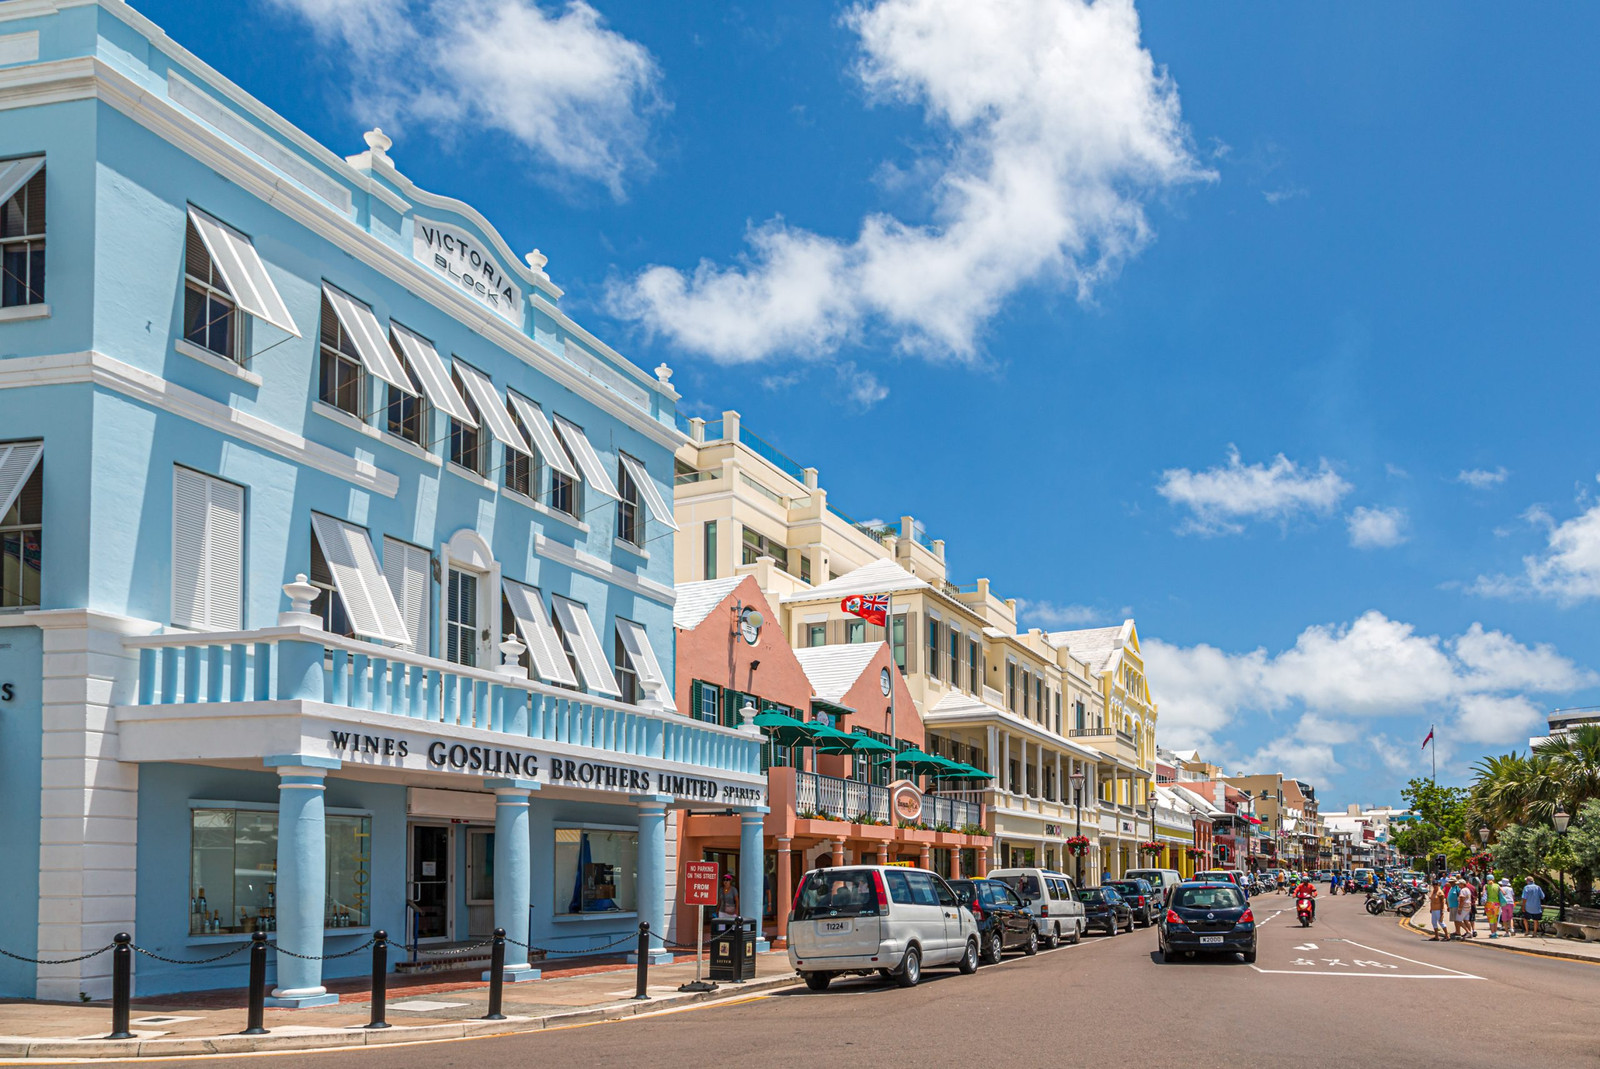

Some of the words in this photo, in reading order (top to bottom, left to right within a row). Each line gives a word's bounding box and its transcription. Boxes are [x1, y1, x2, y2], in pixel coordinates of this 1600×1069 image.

[422, 226, 512, 303] VICTORIA
[435, 253, 498, 304] BLOCK
[331, 730, 408, 757] WINES
[428, 741, 539, 777] GOSLING
[551, 758, 650, 790] BROTHERS
[658, 773, 717, 798] LIMITED
[723, 785, 761, 801] SPIRITS
